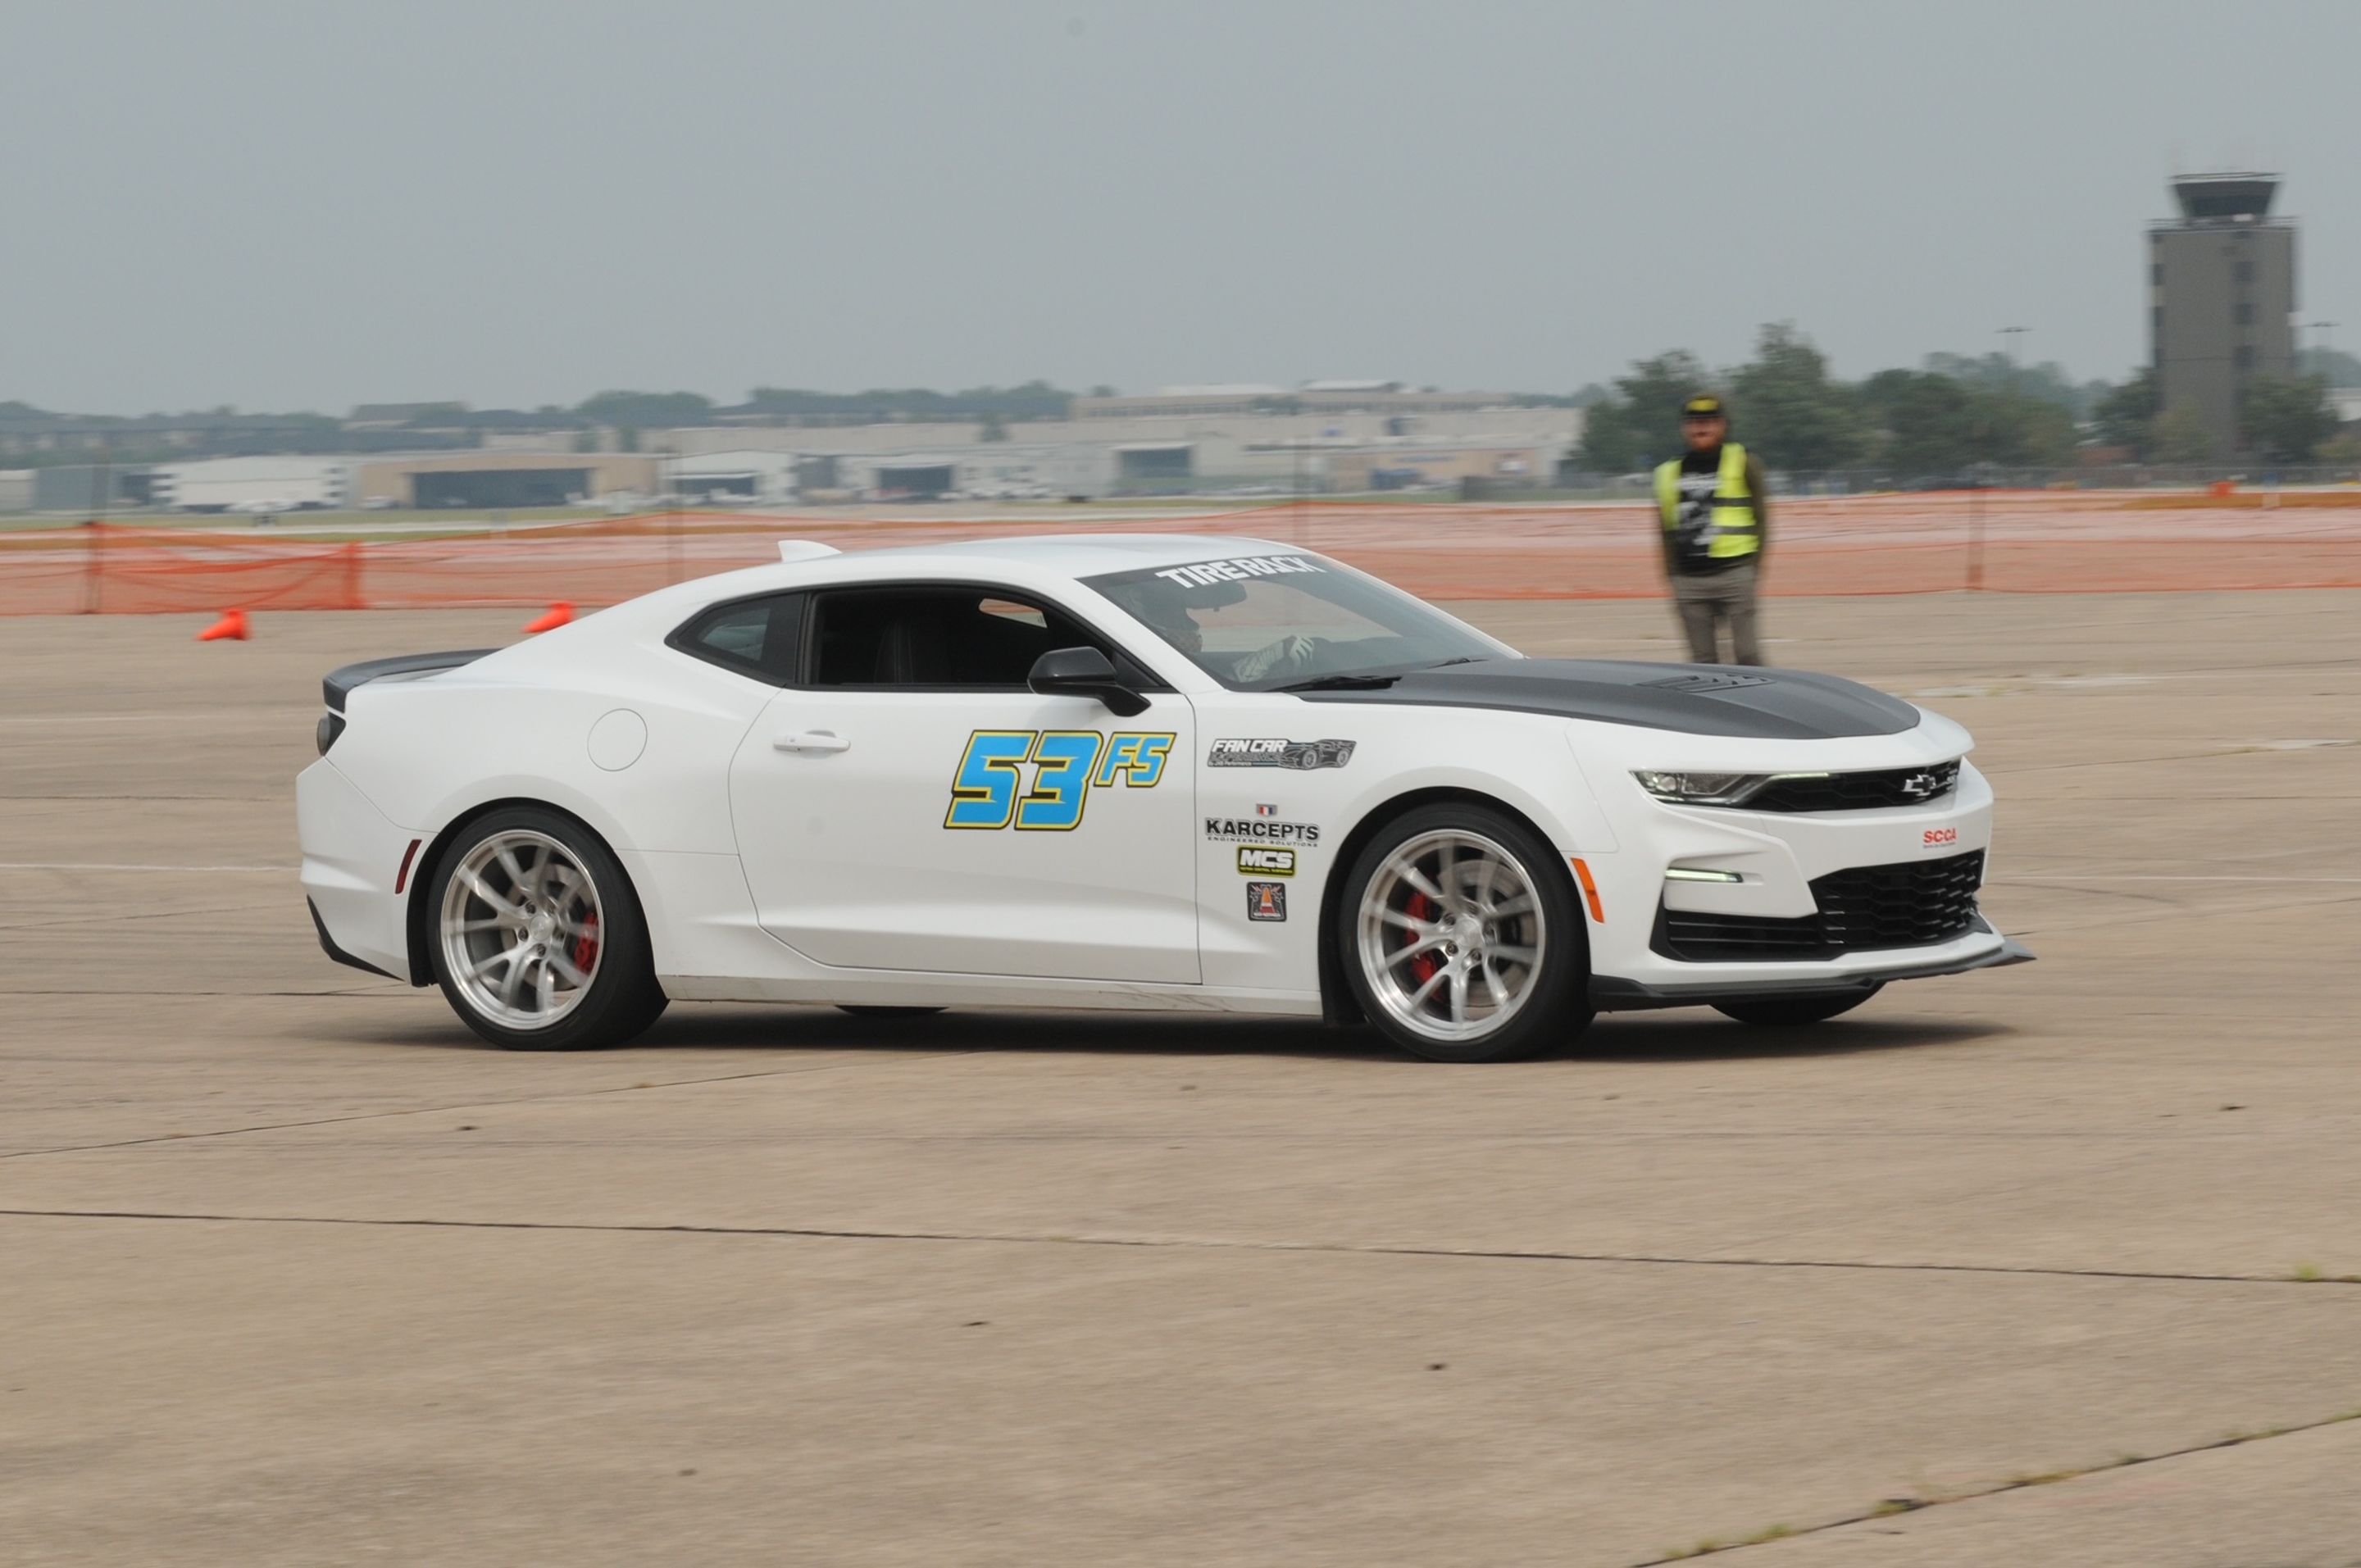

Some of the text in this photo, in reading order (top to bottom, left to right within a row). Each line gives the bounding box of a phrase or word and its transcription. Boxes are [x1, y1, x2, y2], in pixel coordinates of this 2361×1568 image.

[1212, 739, 1287, 752] FAN CAR
[943, 729, 1177, 831] 53 FS
[1206, 820, 1319, 840] KARCEPTS
[1923, 827, 1956, 843] SCCA
[1240, 849, 1294, 868] MCS
